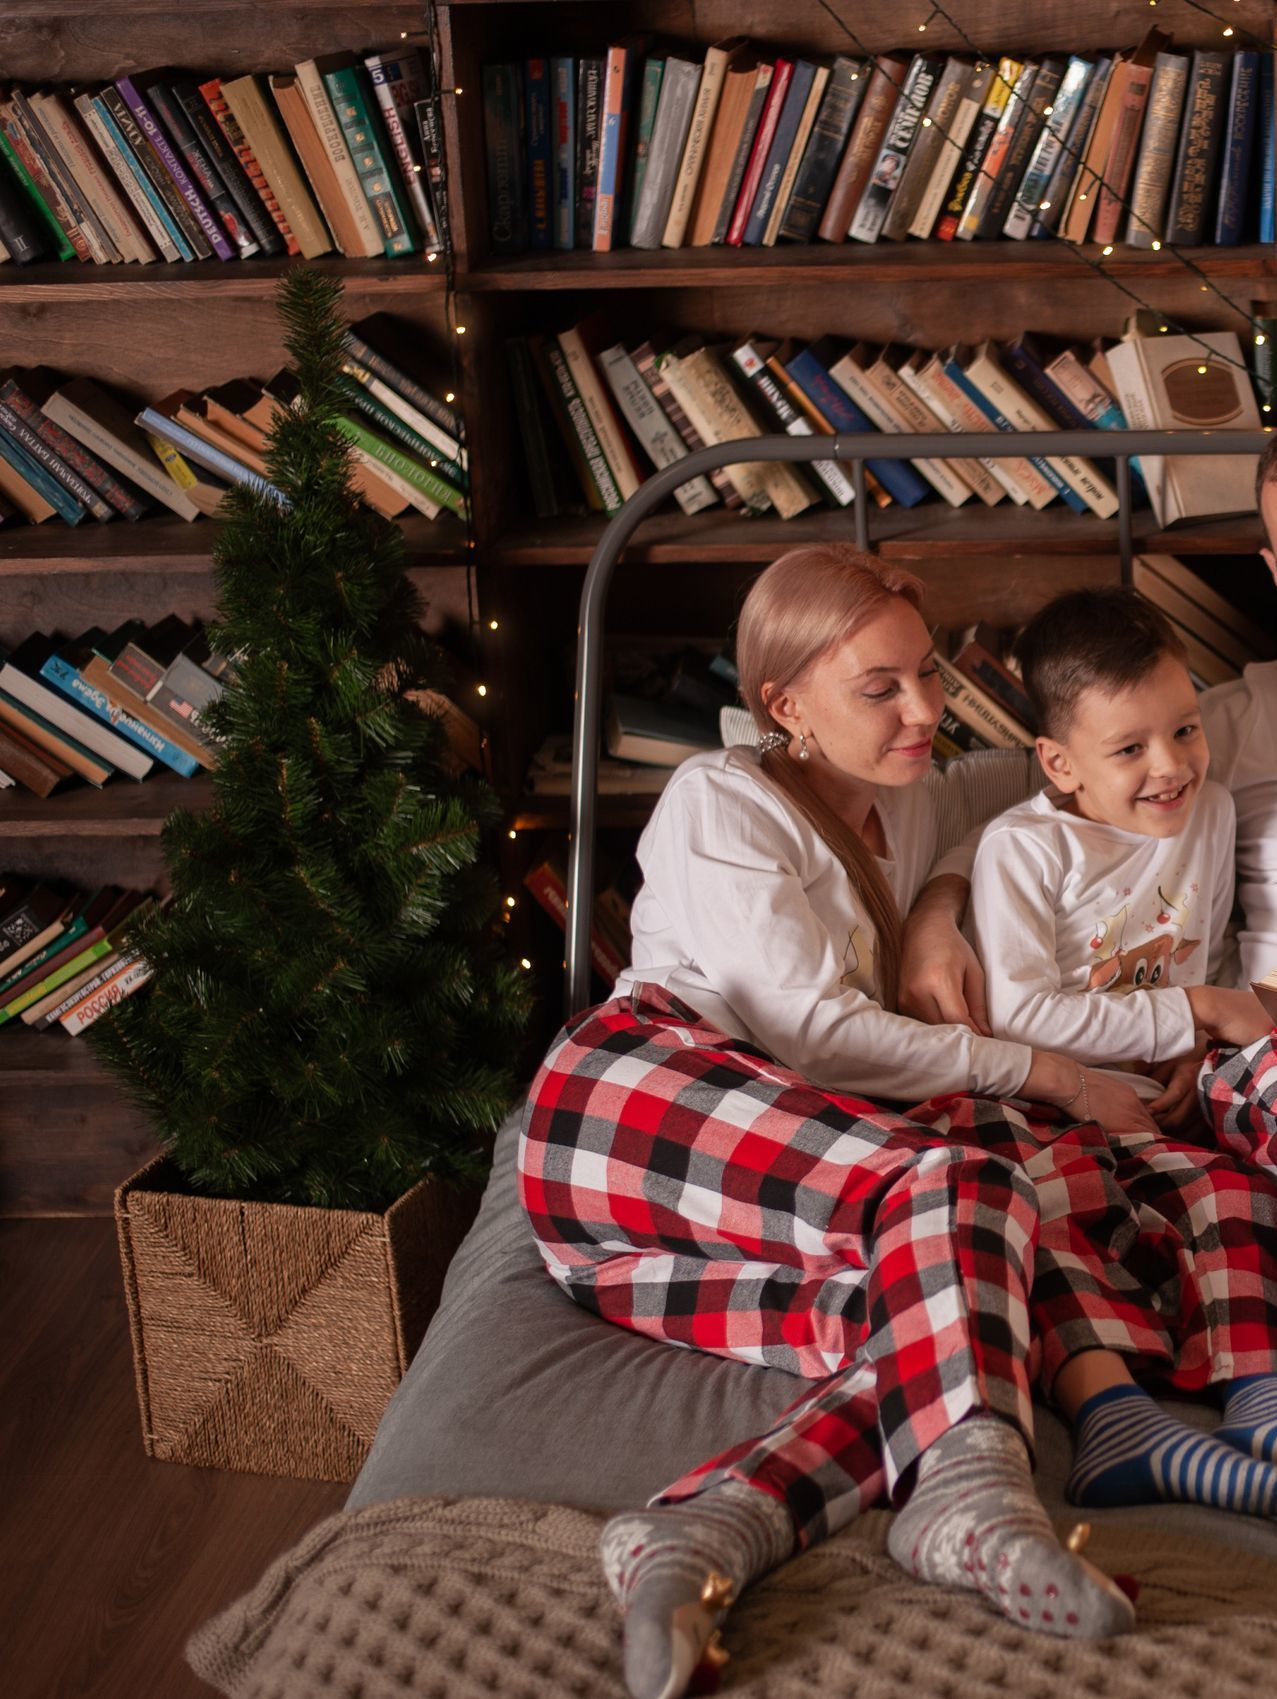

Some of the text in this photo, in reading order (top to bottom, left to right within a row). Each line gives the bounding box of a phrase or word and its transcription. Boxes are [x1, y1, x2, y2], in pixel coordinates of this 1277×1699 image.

[372, 70, 385, 83] 5
[133, 103, 158, 136] 10-11
[308, 82, 346, 163] ВОСКРЕСЕНИЕ
[153, 133, 189, 185] KONTAKTE
[383, 107, 417, 185] ENGLISH
[181, 183, 223, 244] DEUTSCH,
[372, 410, 458, 478] ЭКЛОГИЧЕСКОЕ
[68, 677, 106, 708] Эдема
[116, 711, 168, 752] Изгнание
[74, 982, 122, 1025] РОССИЯ
